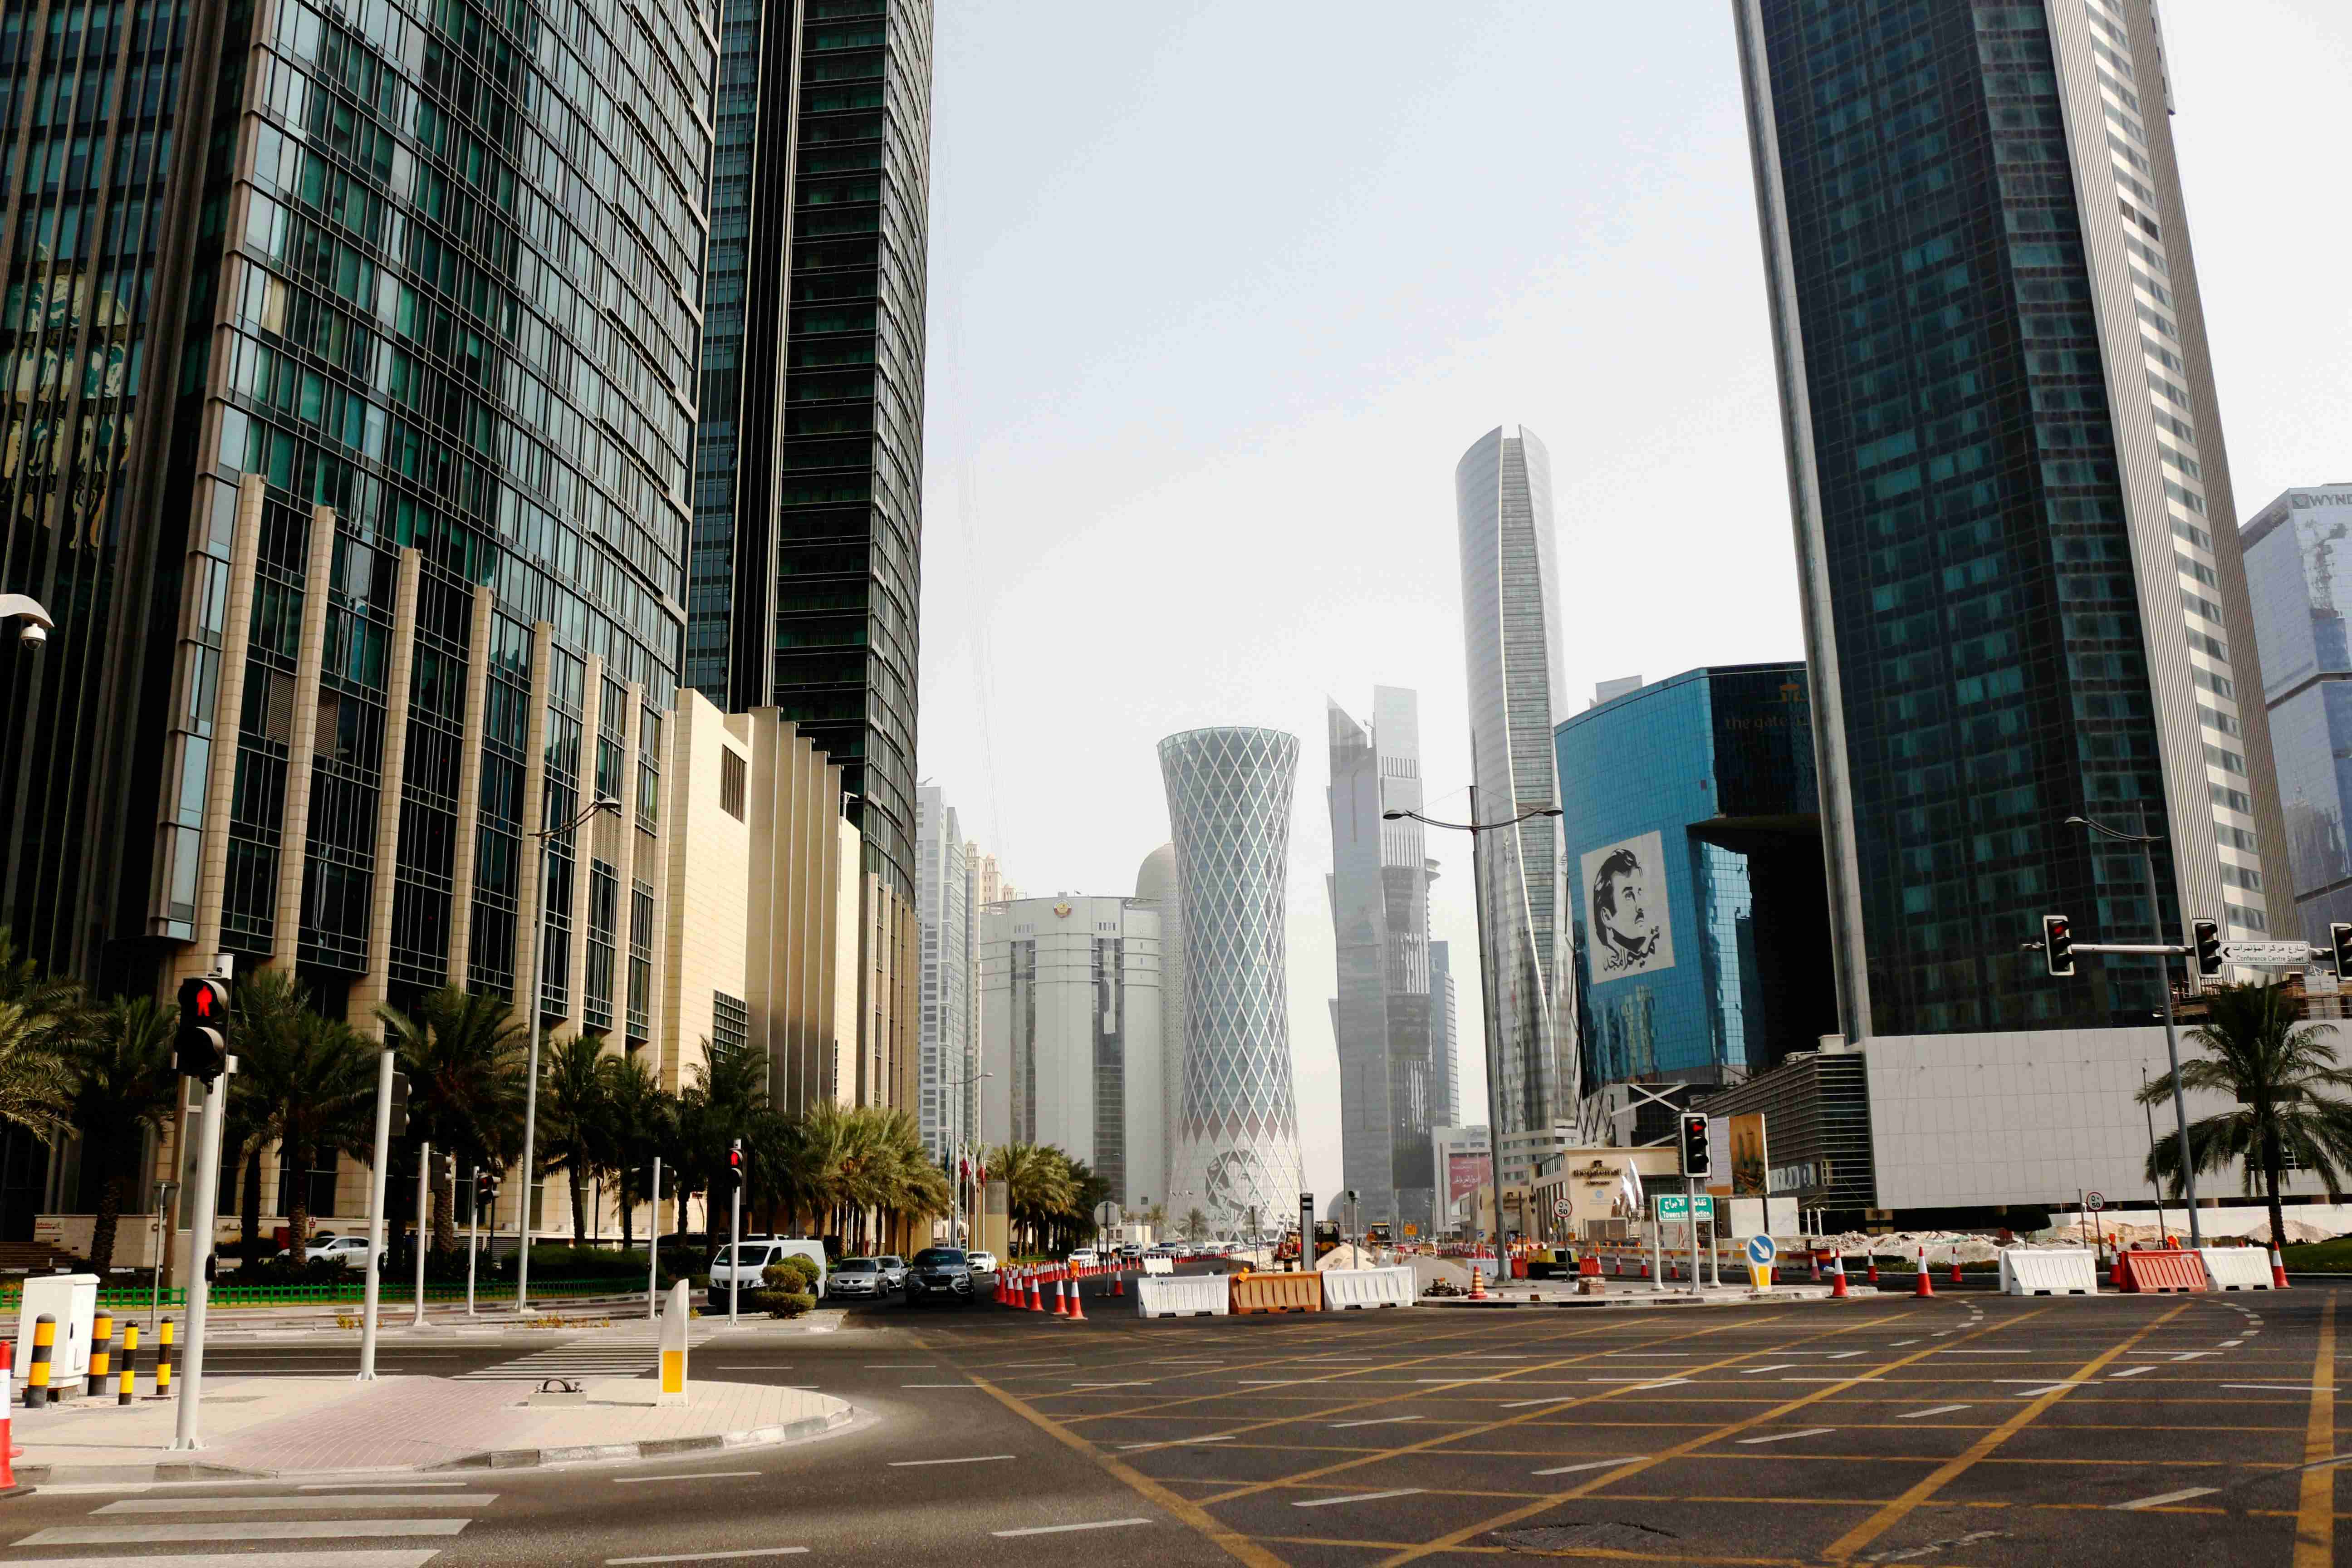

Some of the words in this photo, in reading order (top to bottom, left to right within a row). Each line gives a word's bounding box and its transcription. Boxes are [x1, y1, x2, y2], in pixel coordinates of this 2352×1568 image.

[2233, 944, 2265, 953] المؤتمرات
[2269, 944, 2284, 953] مركز
[2288, 944, 2305, 954] شارع
